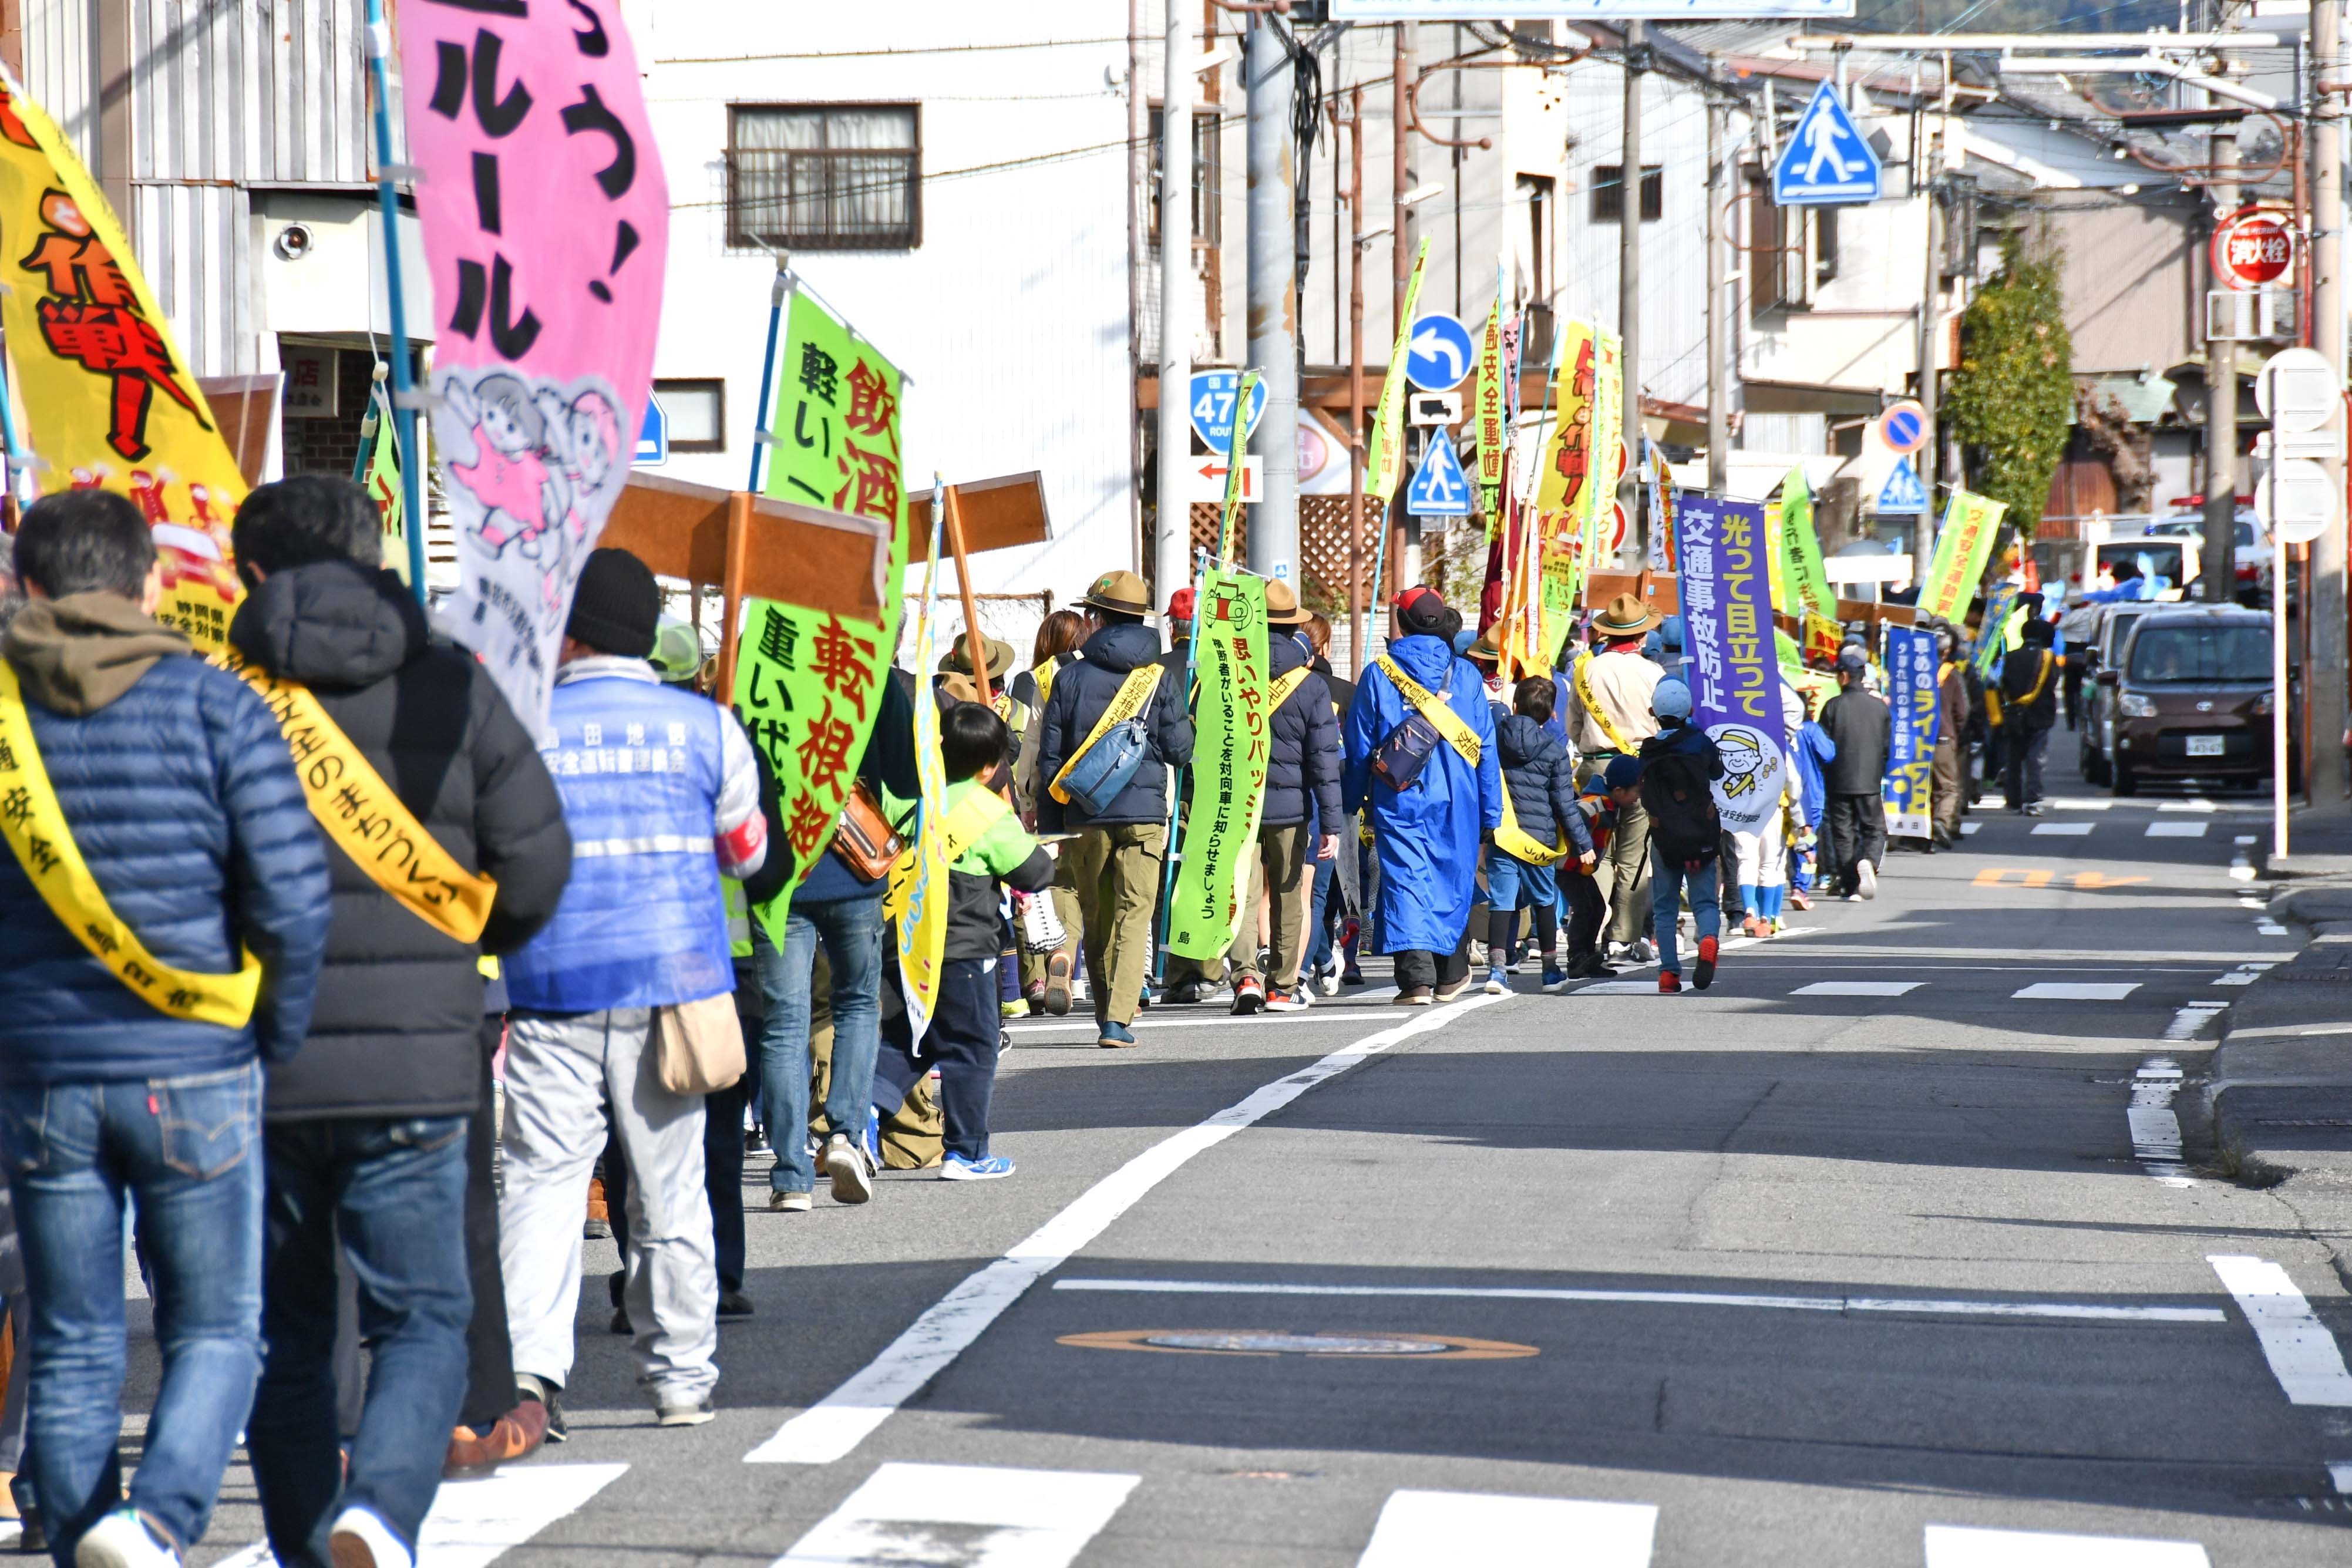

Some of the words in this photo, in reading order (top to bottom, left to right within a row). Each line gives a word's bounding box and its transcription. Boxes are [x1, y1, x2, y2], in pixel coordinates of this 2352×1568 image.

[423, 0, 543, 360] ルール
[2230, 236, 2286, 265] 消火栓
[1683, 508, 1727, 714] 交通事故防止
[1721, 513, 1766, 718] 光って目立って
[0, 716, 62, 875] 通安全
[1202, 637, 1234, 920] 横断者がいることを対向車に知らせましょう
